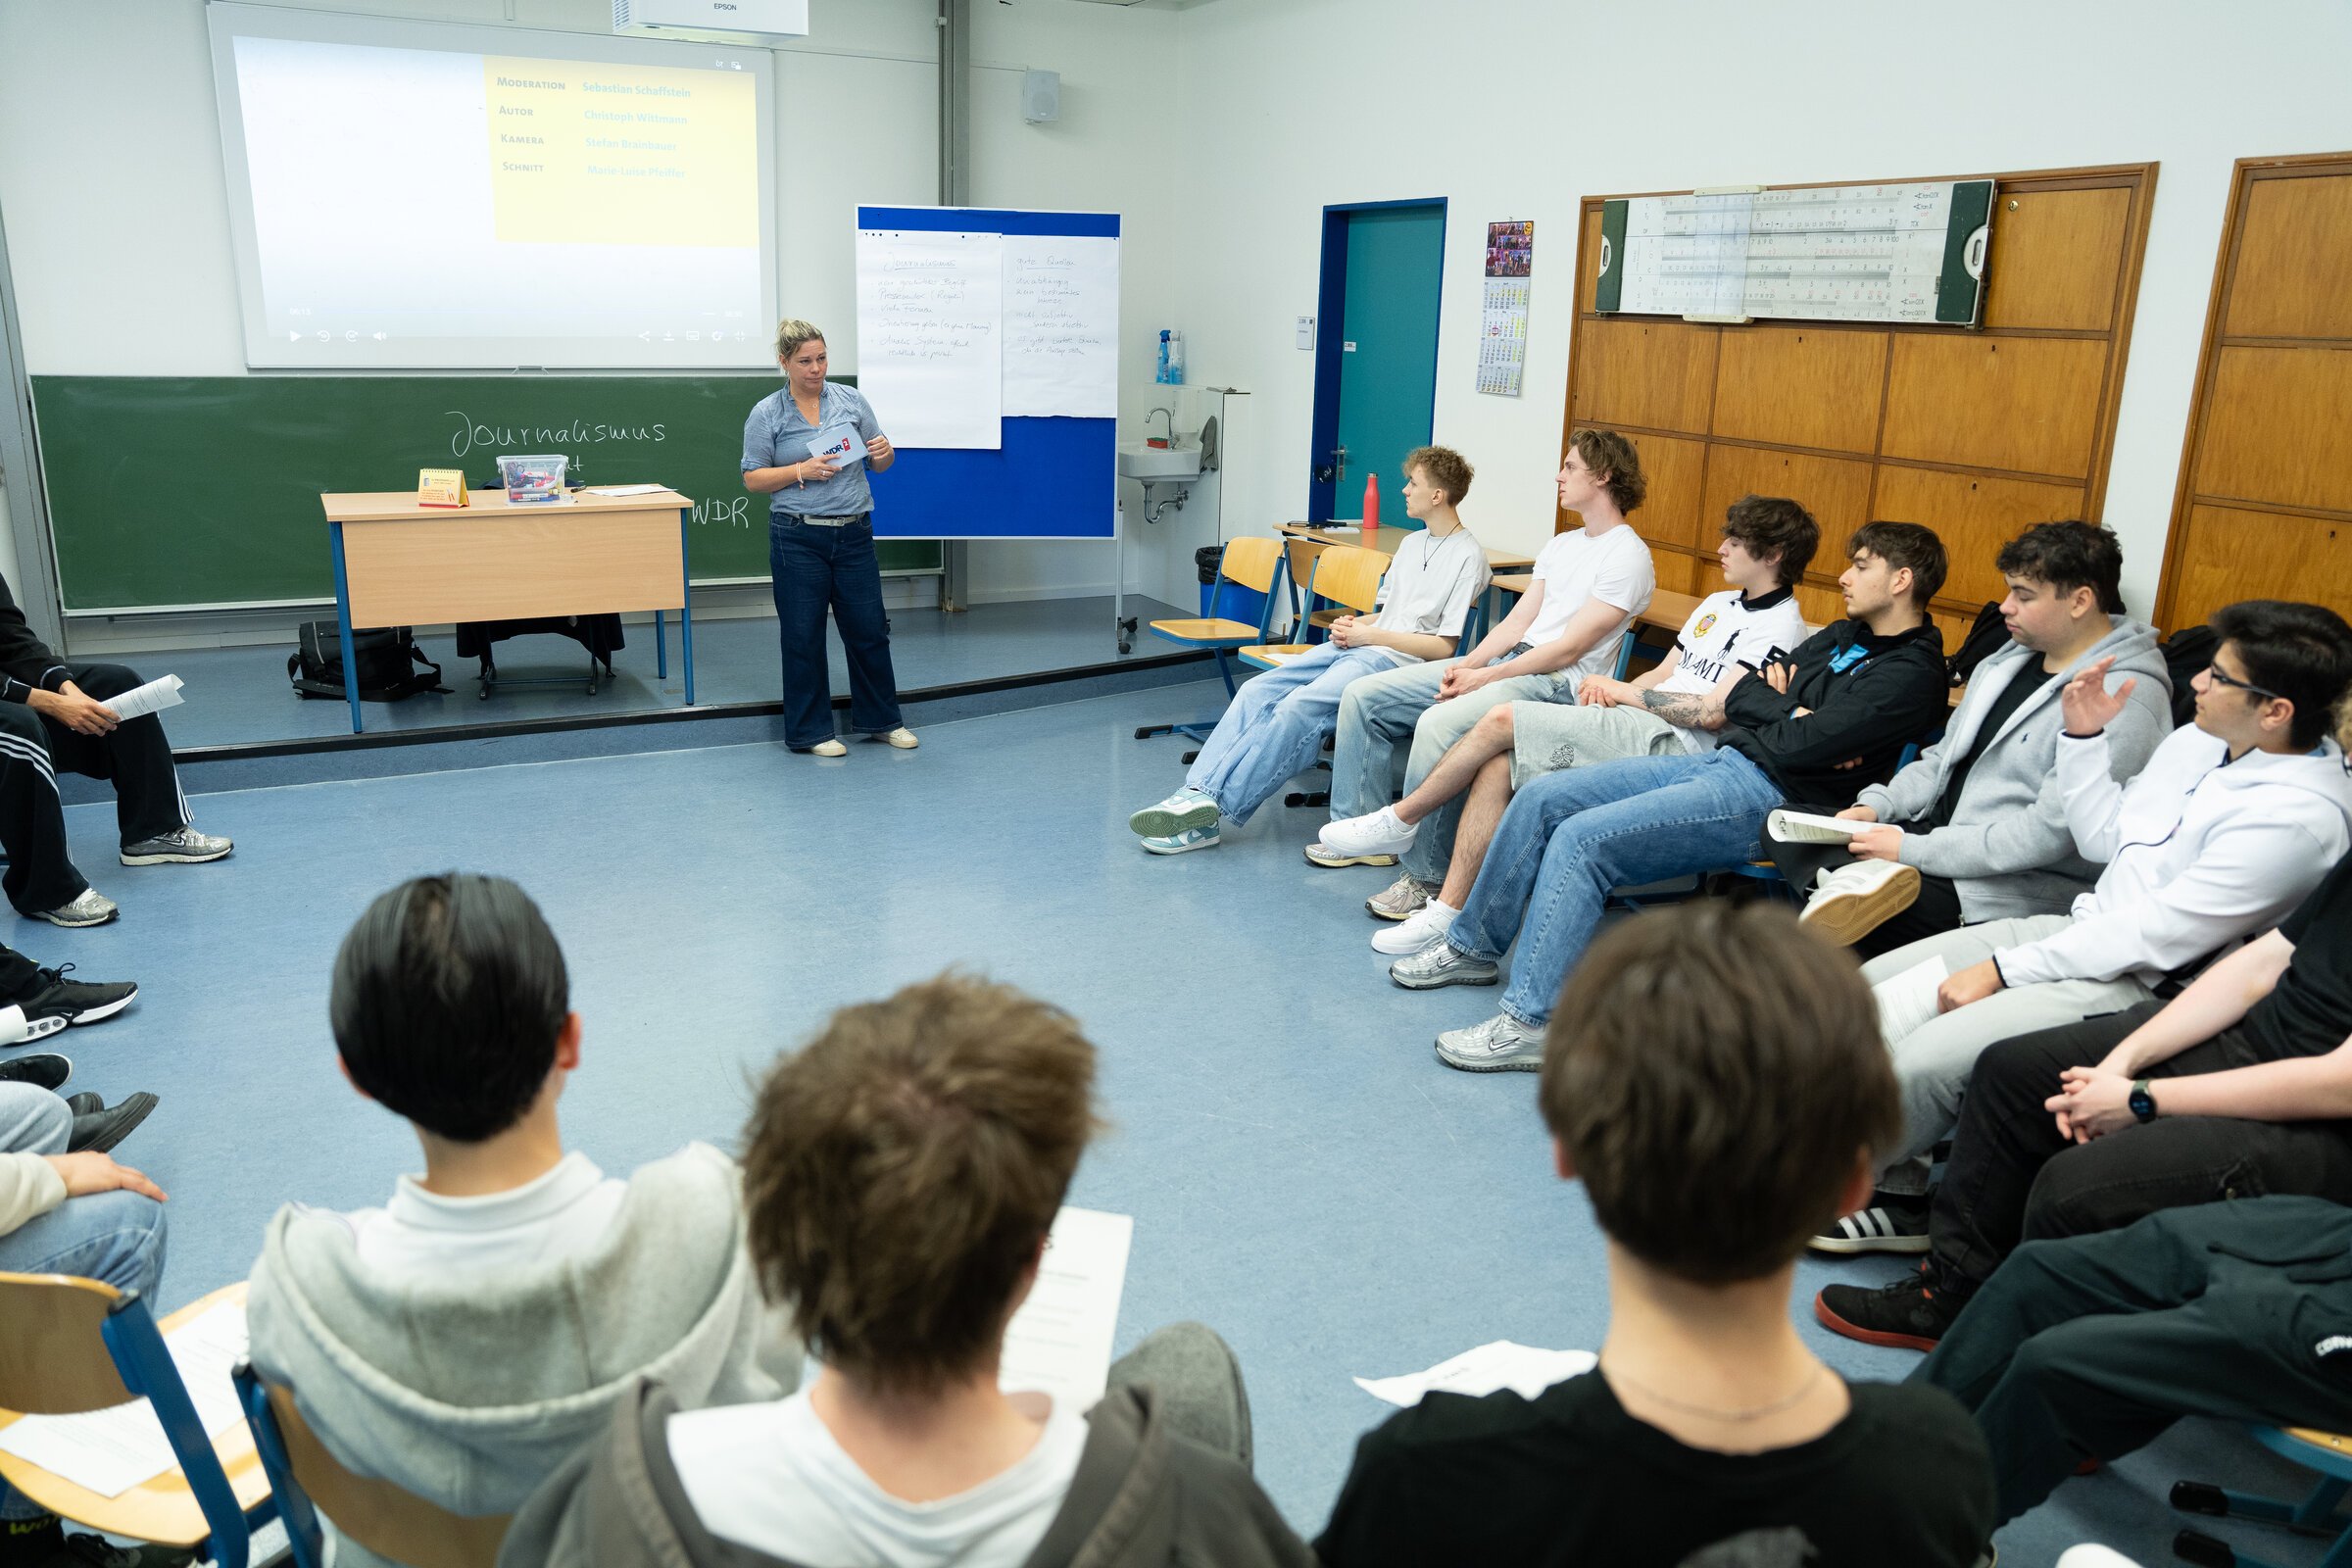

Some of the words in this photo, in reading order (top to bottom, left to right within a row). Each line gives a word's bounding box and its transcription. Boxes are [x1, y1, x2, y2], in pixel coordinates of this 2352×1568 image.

[582, 81, 633, 95] Sebastian
[635, 84, 691, 98] Schaffstein
[499, 105, 534, 117] AUTOR
[584, 110, 634, 122] Christoph
[636, 113, 688, 124] Wittmann
[501, 133, 545, 145] KAMERA
[585, 137, 619, 149] Stefan
[502, 161, 545, 172] SCHNITT
[587, 165, 647, 177] Marie-Luise
[648, 168, 686, 179] Pfeiffer
[444, 411, 666, 458] Journalismus
[691, 497, 749, 528] WDR
[1677, 649, 1726, 684] MIAMI
